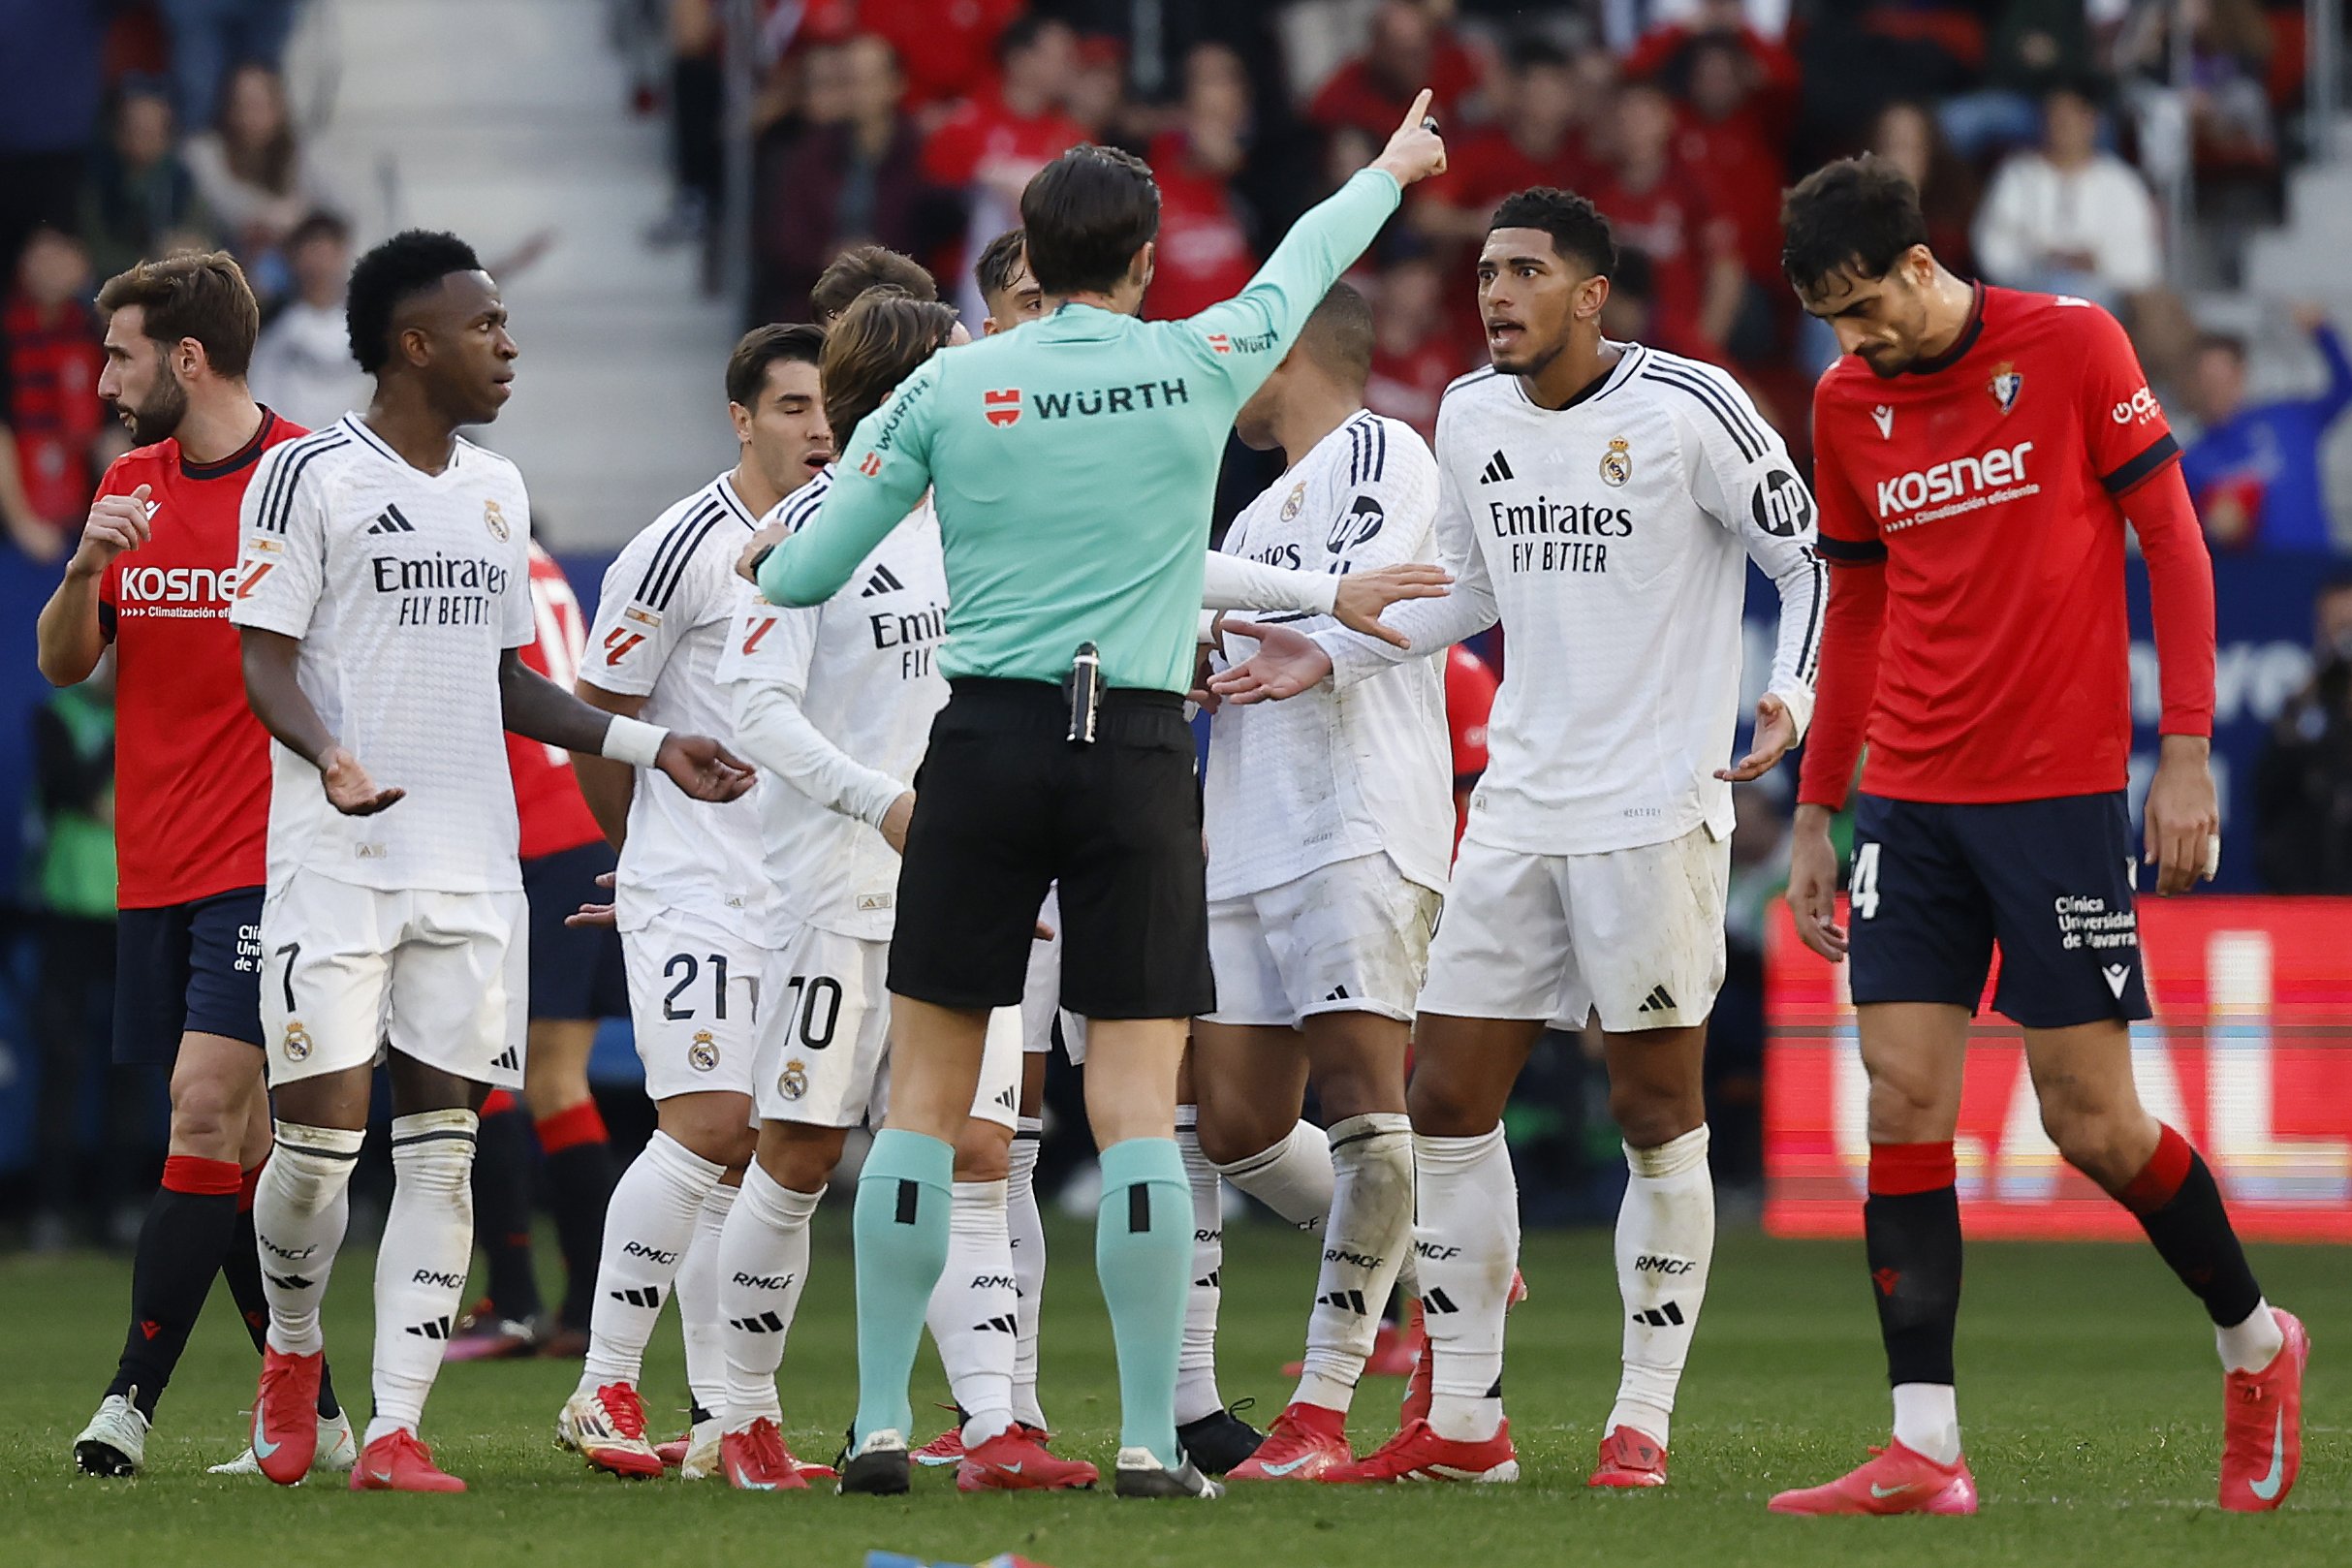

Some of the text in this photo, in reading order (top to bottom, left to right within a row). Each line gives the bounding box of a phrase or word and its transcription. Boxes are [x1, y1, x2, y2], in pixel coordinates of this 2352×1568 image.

[1033, 377, 1188, 419] WÜRTH
[1490, 495, 1633, 537] Emirates
[1753, 470, 1810, 537] hp
[1327, 495, 1384, 555] hp
[372, 550, 509, 596] Emirates
[1513, 542, 1606, 573] FY BTTER
[121, 567, 240, 602] Kosne
[147, 606, 216, 618] Climatización
[399, 596, 489, 626] FLY BETT
[902, 646, 930, 680] FLY
[2062, 931, 2083, 950] de
[234, 956, 252, 972] de
[274, 941, 301, 1014] 7
[664, 953, 727, 1020] 21
[783, 975, 842, 1051] 10
[1324, 1248, 1384, 1270] RMCF
[1634, 1255, 1697, 1275] RMCF
[733, 1270, 795, 1290] RMCF
